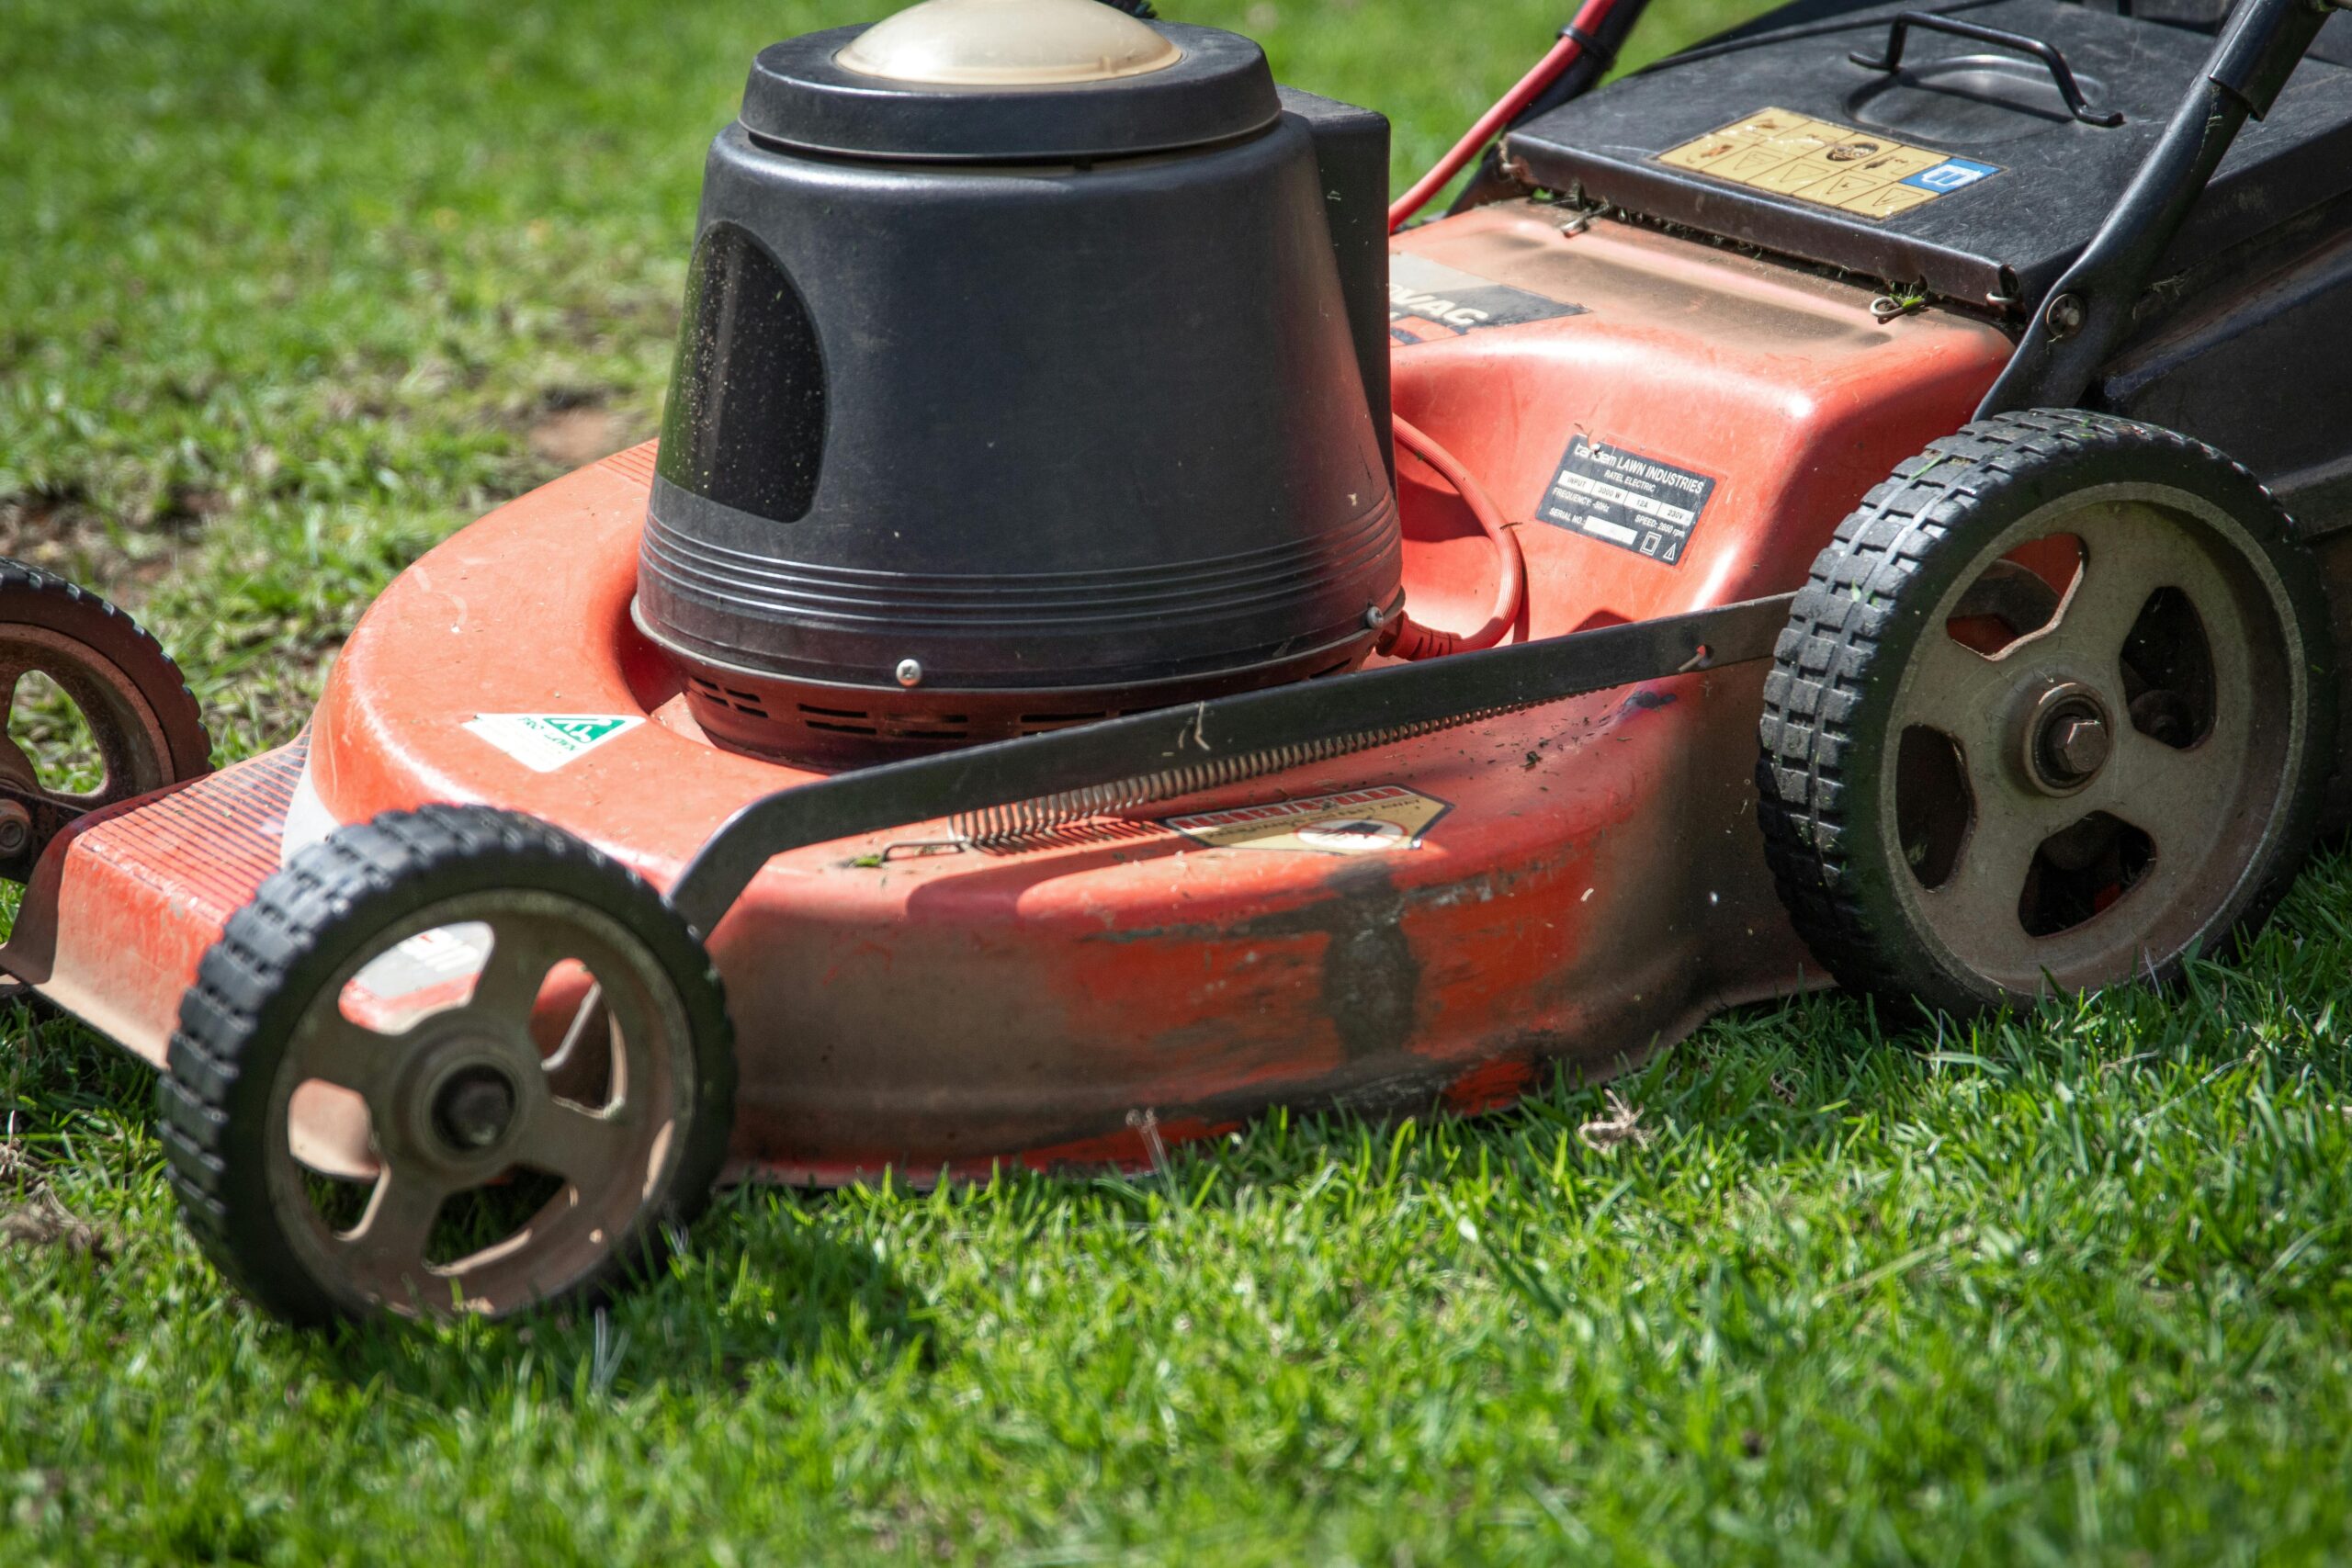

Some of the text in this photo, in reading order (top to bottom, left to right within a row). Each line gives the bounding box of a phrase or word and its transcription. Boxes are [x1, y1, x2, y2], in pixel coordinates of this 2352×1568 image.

[1603, 469, 1657, 492] RATEL ELECTRIC
[1617, 456, 1649, 477] LAWN
[1645, 465, 1704, 494] INDUSTRIES
[1567, 477, 1587, 487] INPUT
[1599, 487, 1613, 498] 3000
[1667, 509, 1684, 520] 230V
[1549, 507, 1572, 523] SERIAL
[1635, 513, 1658, 528] SPEED:
